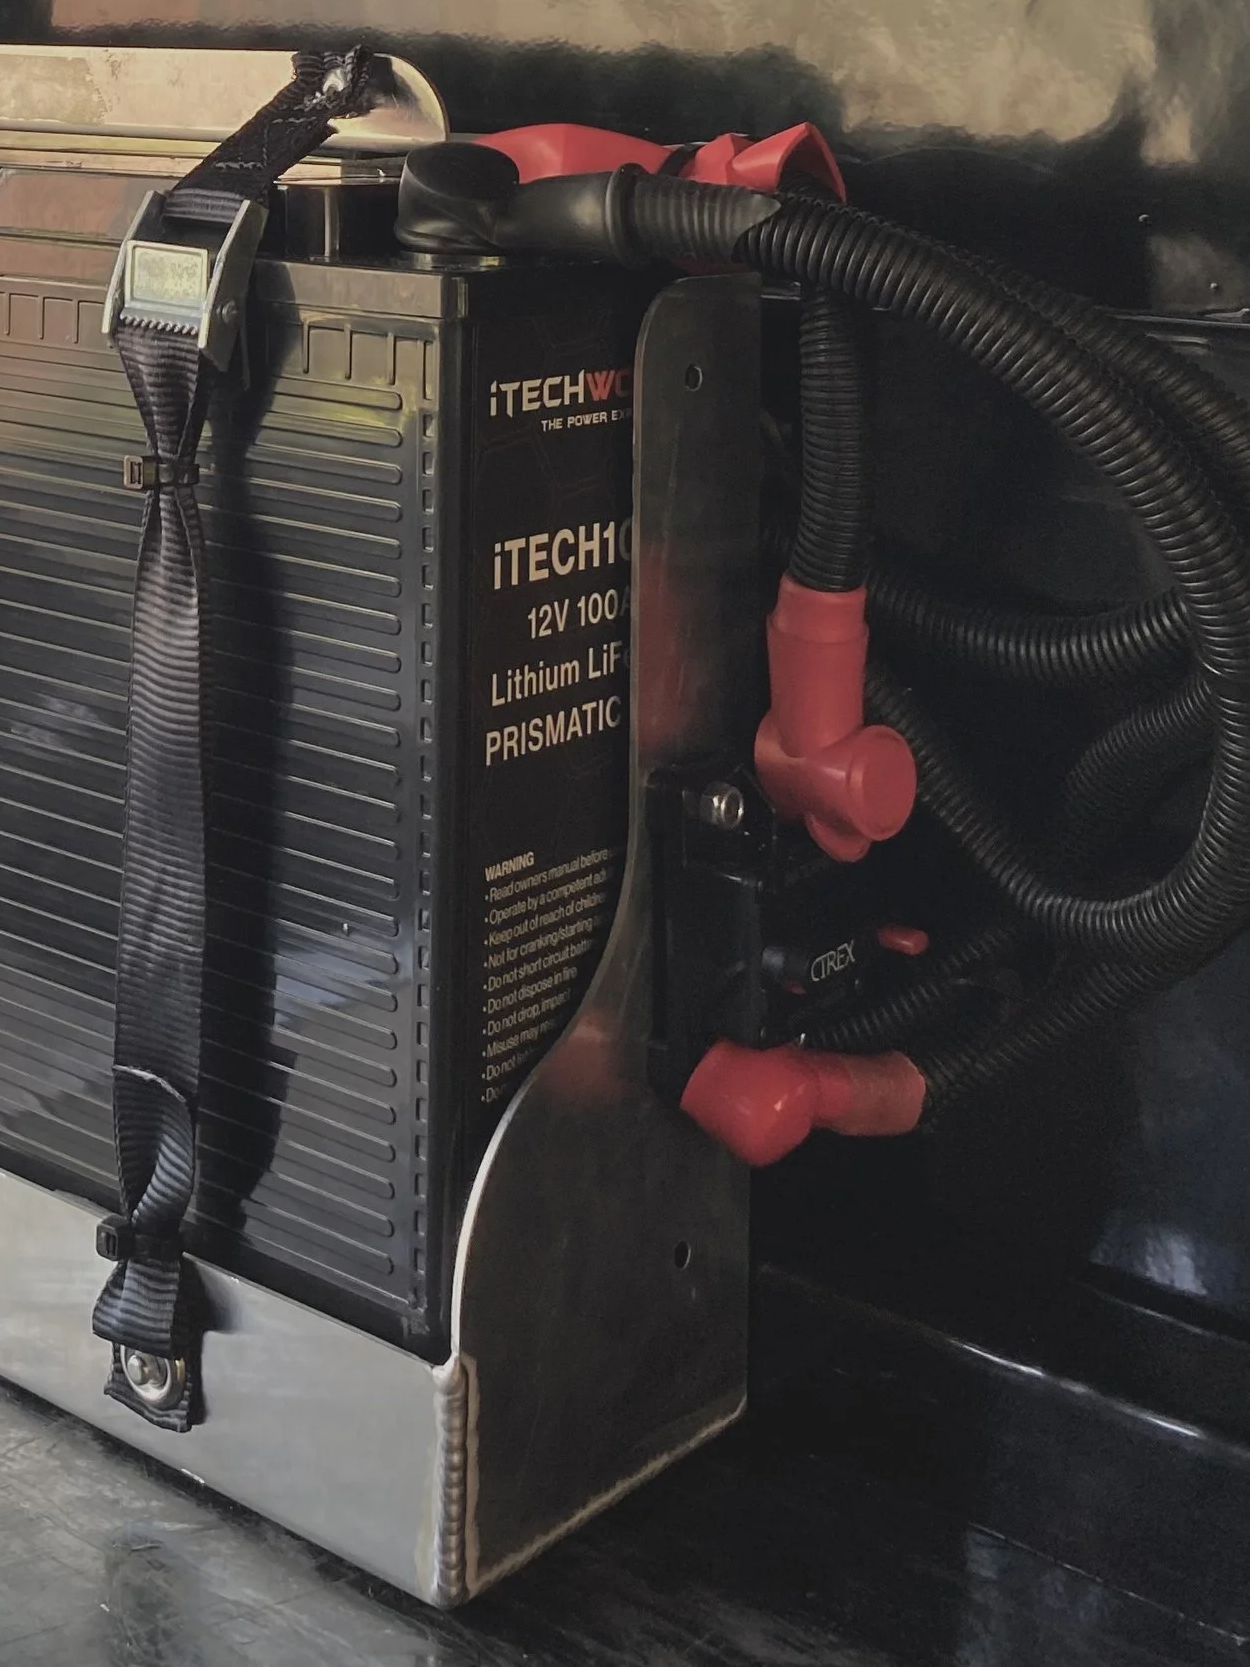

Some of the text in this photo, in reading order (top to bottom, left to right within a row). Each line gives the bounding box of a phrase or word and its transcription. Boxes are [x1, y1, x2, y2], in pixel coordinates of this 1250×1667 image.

[540, 417, 563, 432] THE
[567, 411, 608, 429] POWER
[528, 599, 569, 639] 12V
[491, 656, 580, 708] Lithium
[485, 694, 622, 767] PRISMATIC
[485, 851, 534, 882] WARNING
[490, 882, 514, 903] Read
[515, 871, 547, 893] owners
[548, 857, 580, 881] manual
[581, 848, 609, 870] before
[489, 901, 526, 925] Operate
[527, 897, 539, 910] by
[546, 874, 592, 901] competent
[488, 927, 513, 947] Keep
[514, 922, 528, 937] out
[529, 917, 538, 930] of
[540, 907, 564, 927] reach
[566, 902, 574, 915] of
[488, 950, 505, 969] Not
[506, 945, 519, 960] for
[488, 976, 501, 991] Do
[502, 967, 516, 985] not
[519, 959, 541, 979] short
[542, 947, 569, 968] circuit
[487, 966, 577, 1014] Do not dispose in fire
[486, 1034, 518, 1057] Misuse
[520, 1026, 538, 1044] may
[487, 1020, 500, 1036] Do
[502, 1010, 516, 1029] not
[486, 1064, 500, 1080] Do
